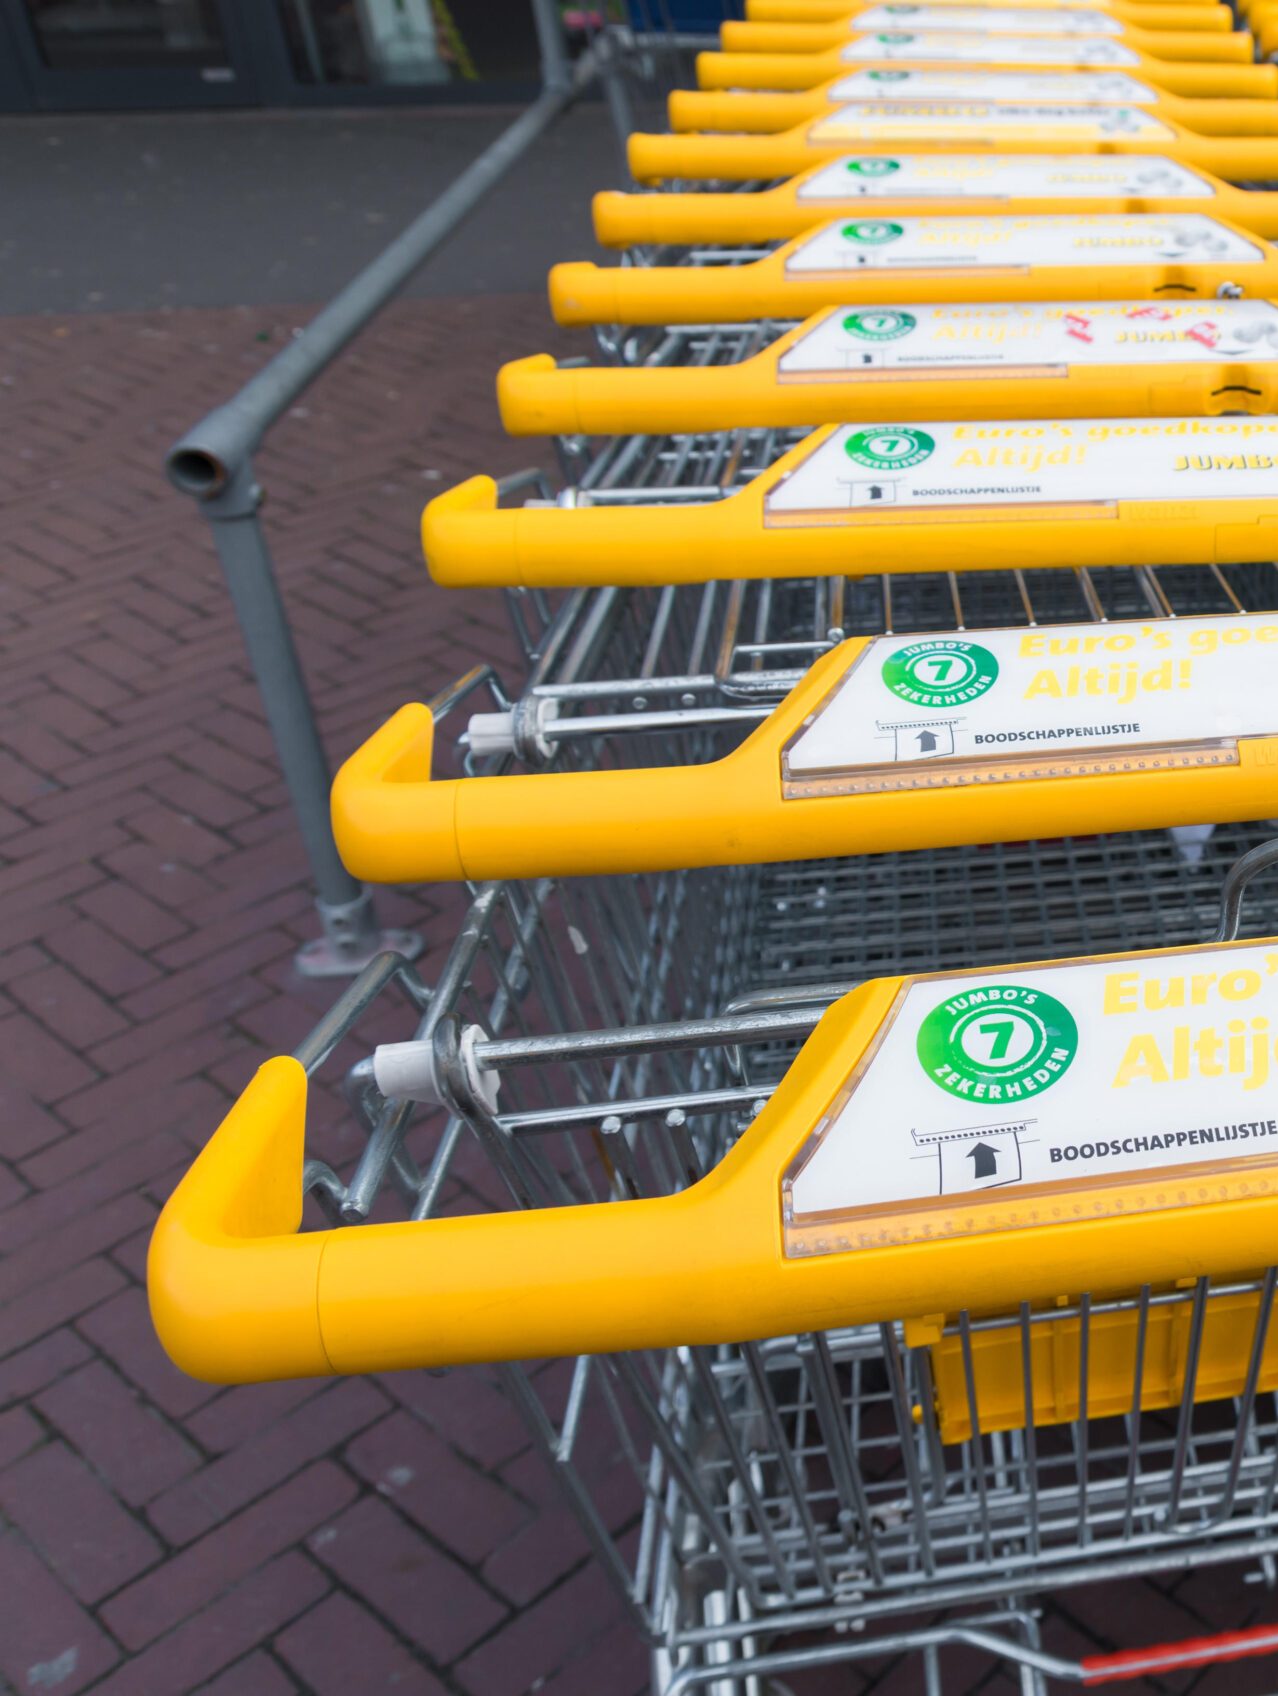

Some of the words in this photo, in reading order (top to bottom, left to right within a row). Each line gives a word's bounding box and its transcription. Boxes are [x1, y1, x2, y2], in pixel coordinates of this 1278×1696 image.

[880, 440, 900, 453] 7
[952, 423, 1073, 441] Euro's
[952, 443, 1087, 474] Altijd!
[912, 485, 1042, 497] BOODSCHAPPENLIJSTJE
[902, 641, 973, 657] JUMBO'S
[1017, 625, 1172, 659] Euro's
[927, 659, 954, 682] 7
[1022, 658, 1193, 705] Altijd!
[892, 674, 993, 705] ZEKERHEDEN
[974, 722, 1141, 745] BOODSCHAPPENLIJSTJE
[944, 988, 1039, 1017] JUMBO'S
[979, 1020, 1015, 1061] 7
[933, 1047, 1071, 1100] ZEKERHEDEN
[1049, 1119, 1278, 1164] BOODSCHAPPENLIJSTJE
